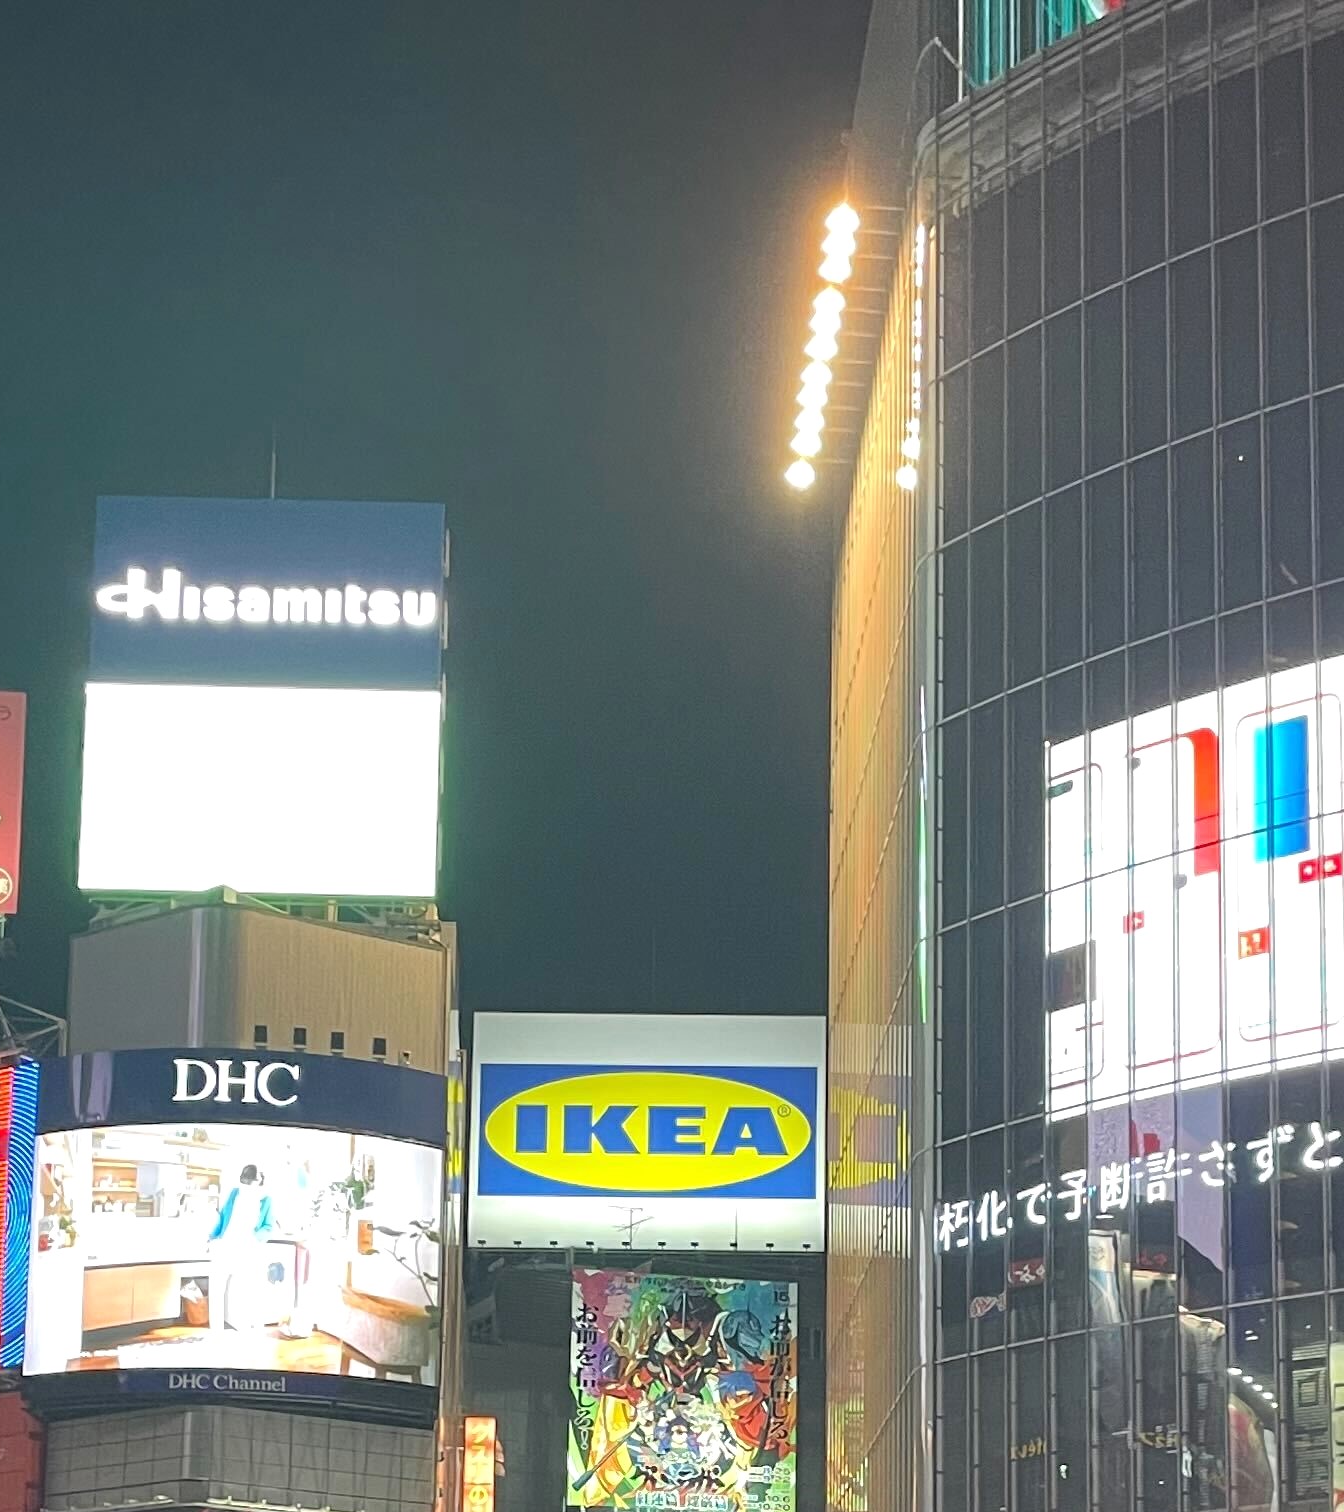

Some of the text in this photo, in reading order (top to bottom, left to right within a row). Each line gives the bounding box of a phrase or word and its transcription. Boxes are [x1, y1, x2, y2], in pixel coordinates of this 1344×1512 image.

[96, 567, 438, 627] Hisamitsu
[172, 1059, 301, 1106] DHC
[515, 1104, 789, 1156] IKEA
[168, 1373, 287, 1392] DHC Channel
